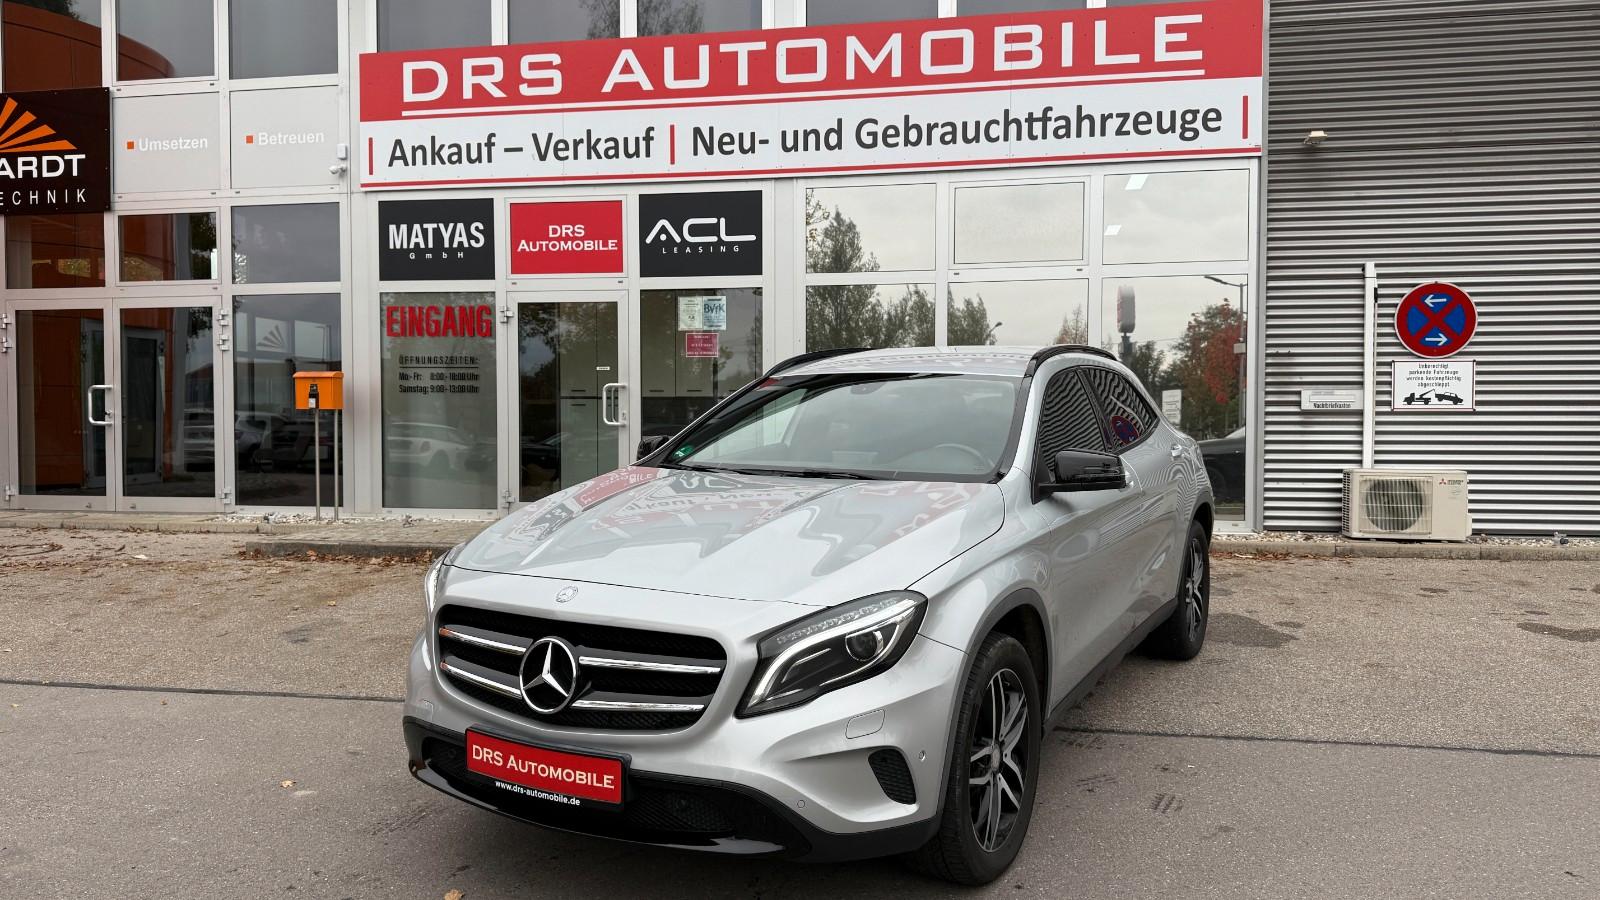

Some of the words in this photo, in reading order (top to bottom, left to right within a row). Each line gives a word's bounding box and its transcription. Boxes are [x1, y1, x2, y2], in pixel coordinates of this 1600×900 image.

[402, 53, 563, 103] DRS
[601, 14, 1203, 93] AUTOMOBILE
[258, 131, 325, 146] Betreuen
[692, 126, 770, 156] Neu-
[781, 118, 843, 152] und
[855, 104, 1223, 149] Gebrauchtfahrzeuge
[138, 137, 208, 151] Umsetzen
[388, 133, 496, 167] Ankauf
[532, 126, 655, 162] Verkauf
[389, 221, 485, 250] MATYAS
[548, 224, 585, 238] DRS
[645, 217, 757, 244] ACL
[517, 239, 618, 252] AUTOMOBILE
[662, 245, 740, 254] LEASING
[386, 304, 493, 337] EINGANG
[466, 372, 479, 381] Uhr
[399, 384, 429, 395] Samstag:
[466, 384, 479, 393] Uhr
[472, 744, 504, 766] DRS
[507, 755, 615, 789] AUTOMOBILE
[495, 781, 581, 806] www.drs-automobile.de
